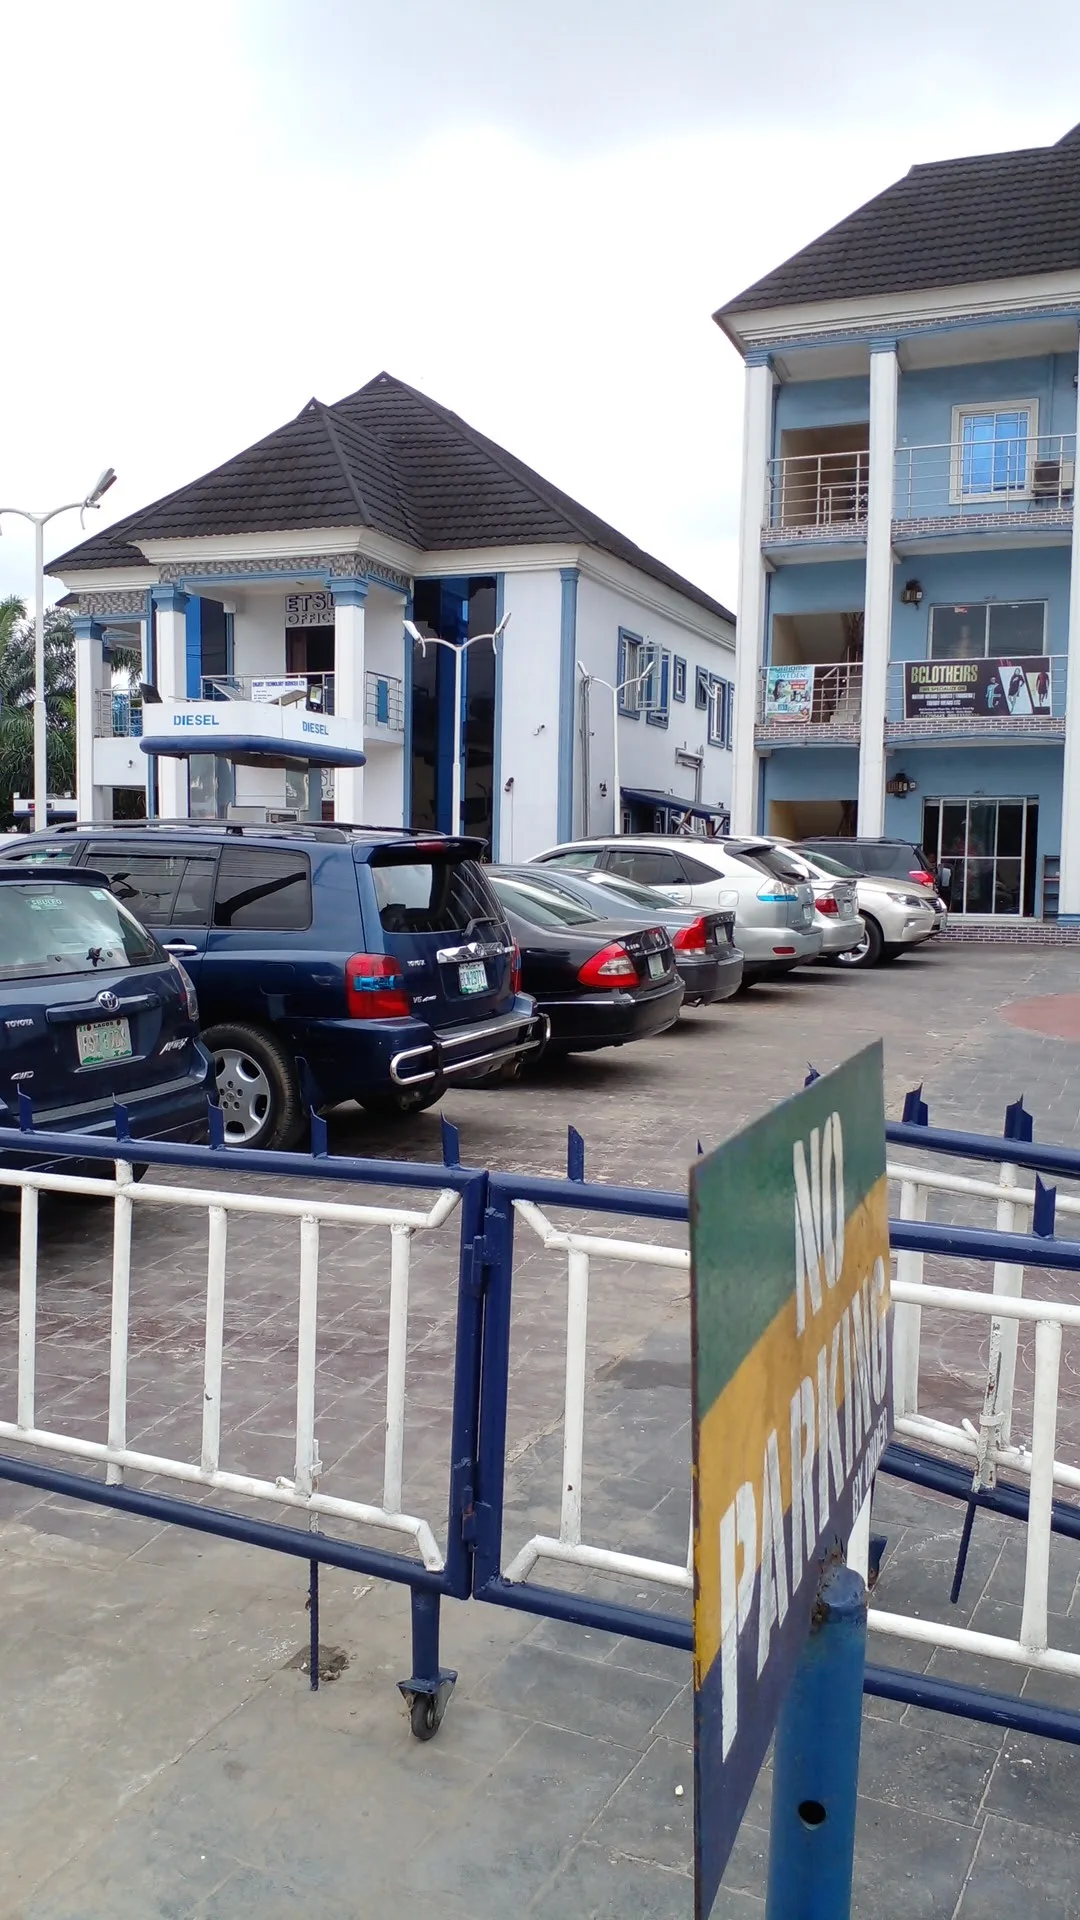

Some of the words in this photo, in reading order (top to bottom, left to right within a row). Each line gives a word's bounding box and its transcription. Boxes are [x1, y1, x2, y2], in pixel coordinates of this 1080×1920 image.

[173, 714, 219, 726] DIESEL
[302, 721, 329, 735] DIESEL
[5, 1018, 34, 1028] TOYOTA
[93, 1021, 114, 1029] LAGOS
[10, 1070, 34, 1080] 4WD
[793, 1111, 845, 1338] NO
[852, 1460, 864, 1524] BY
[719, 1255, 887, 1763] PARKING
